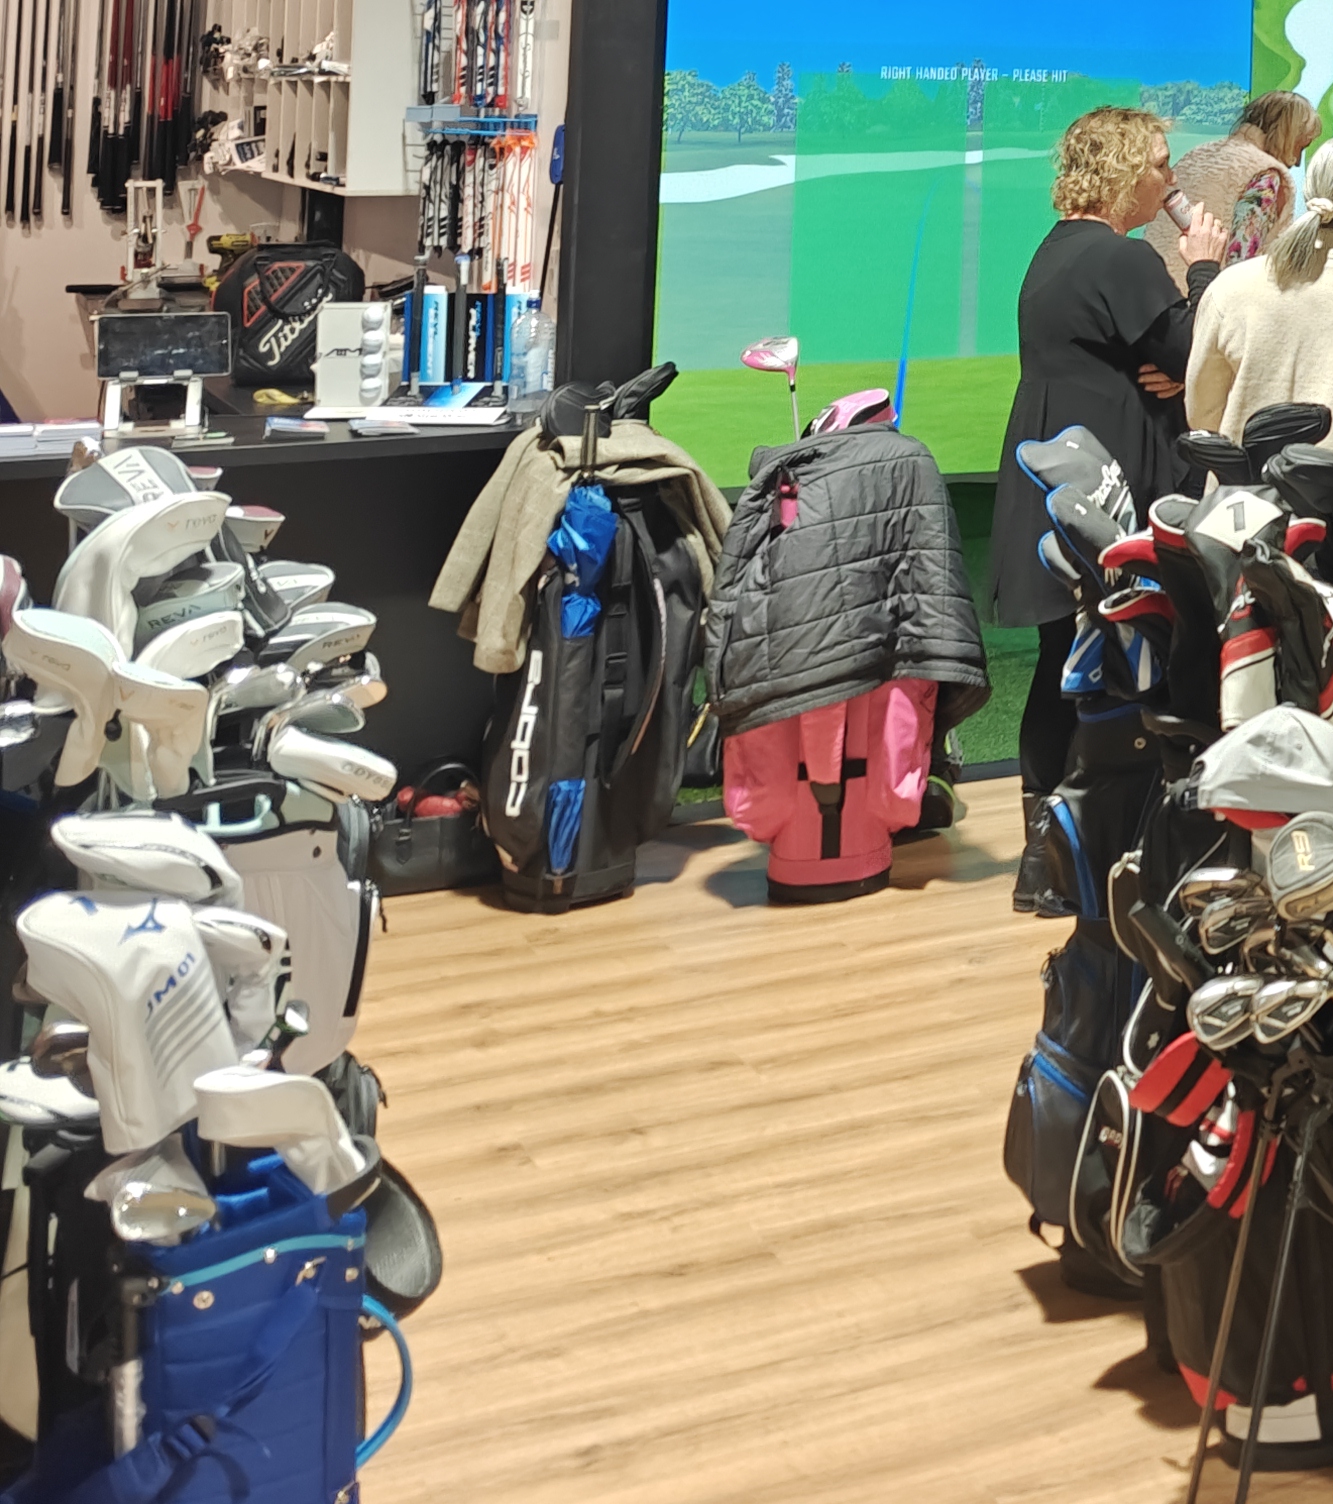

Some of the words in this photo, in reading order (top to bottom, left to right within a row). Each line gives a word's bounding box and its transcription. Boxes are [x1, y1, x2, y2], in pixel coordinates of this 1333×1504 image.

[880, 65, 912, 80] RIGHT
[916, 66, 958, 81] HANDED
[961, 67, 998, 81] PLAYER
[1012, 68, 1048, 83] PLEASE
[1051, 69, 1069, 83] HIT
